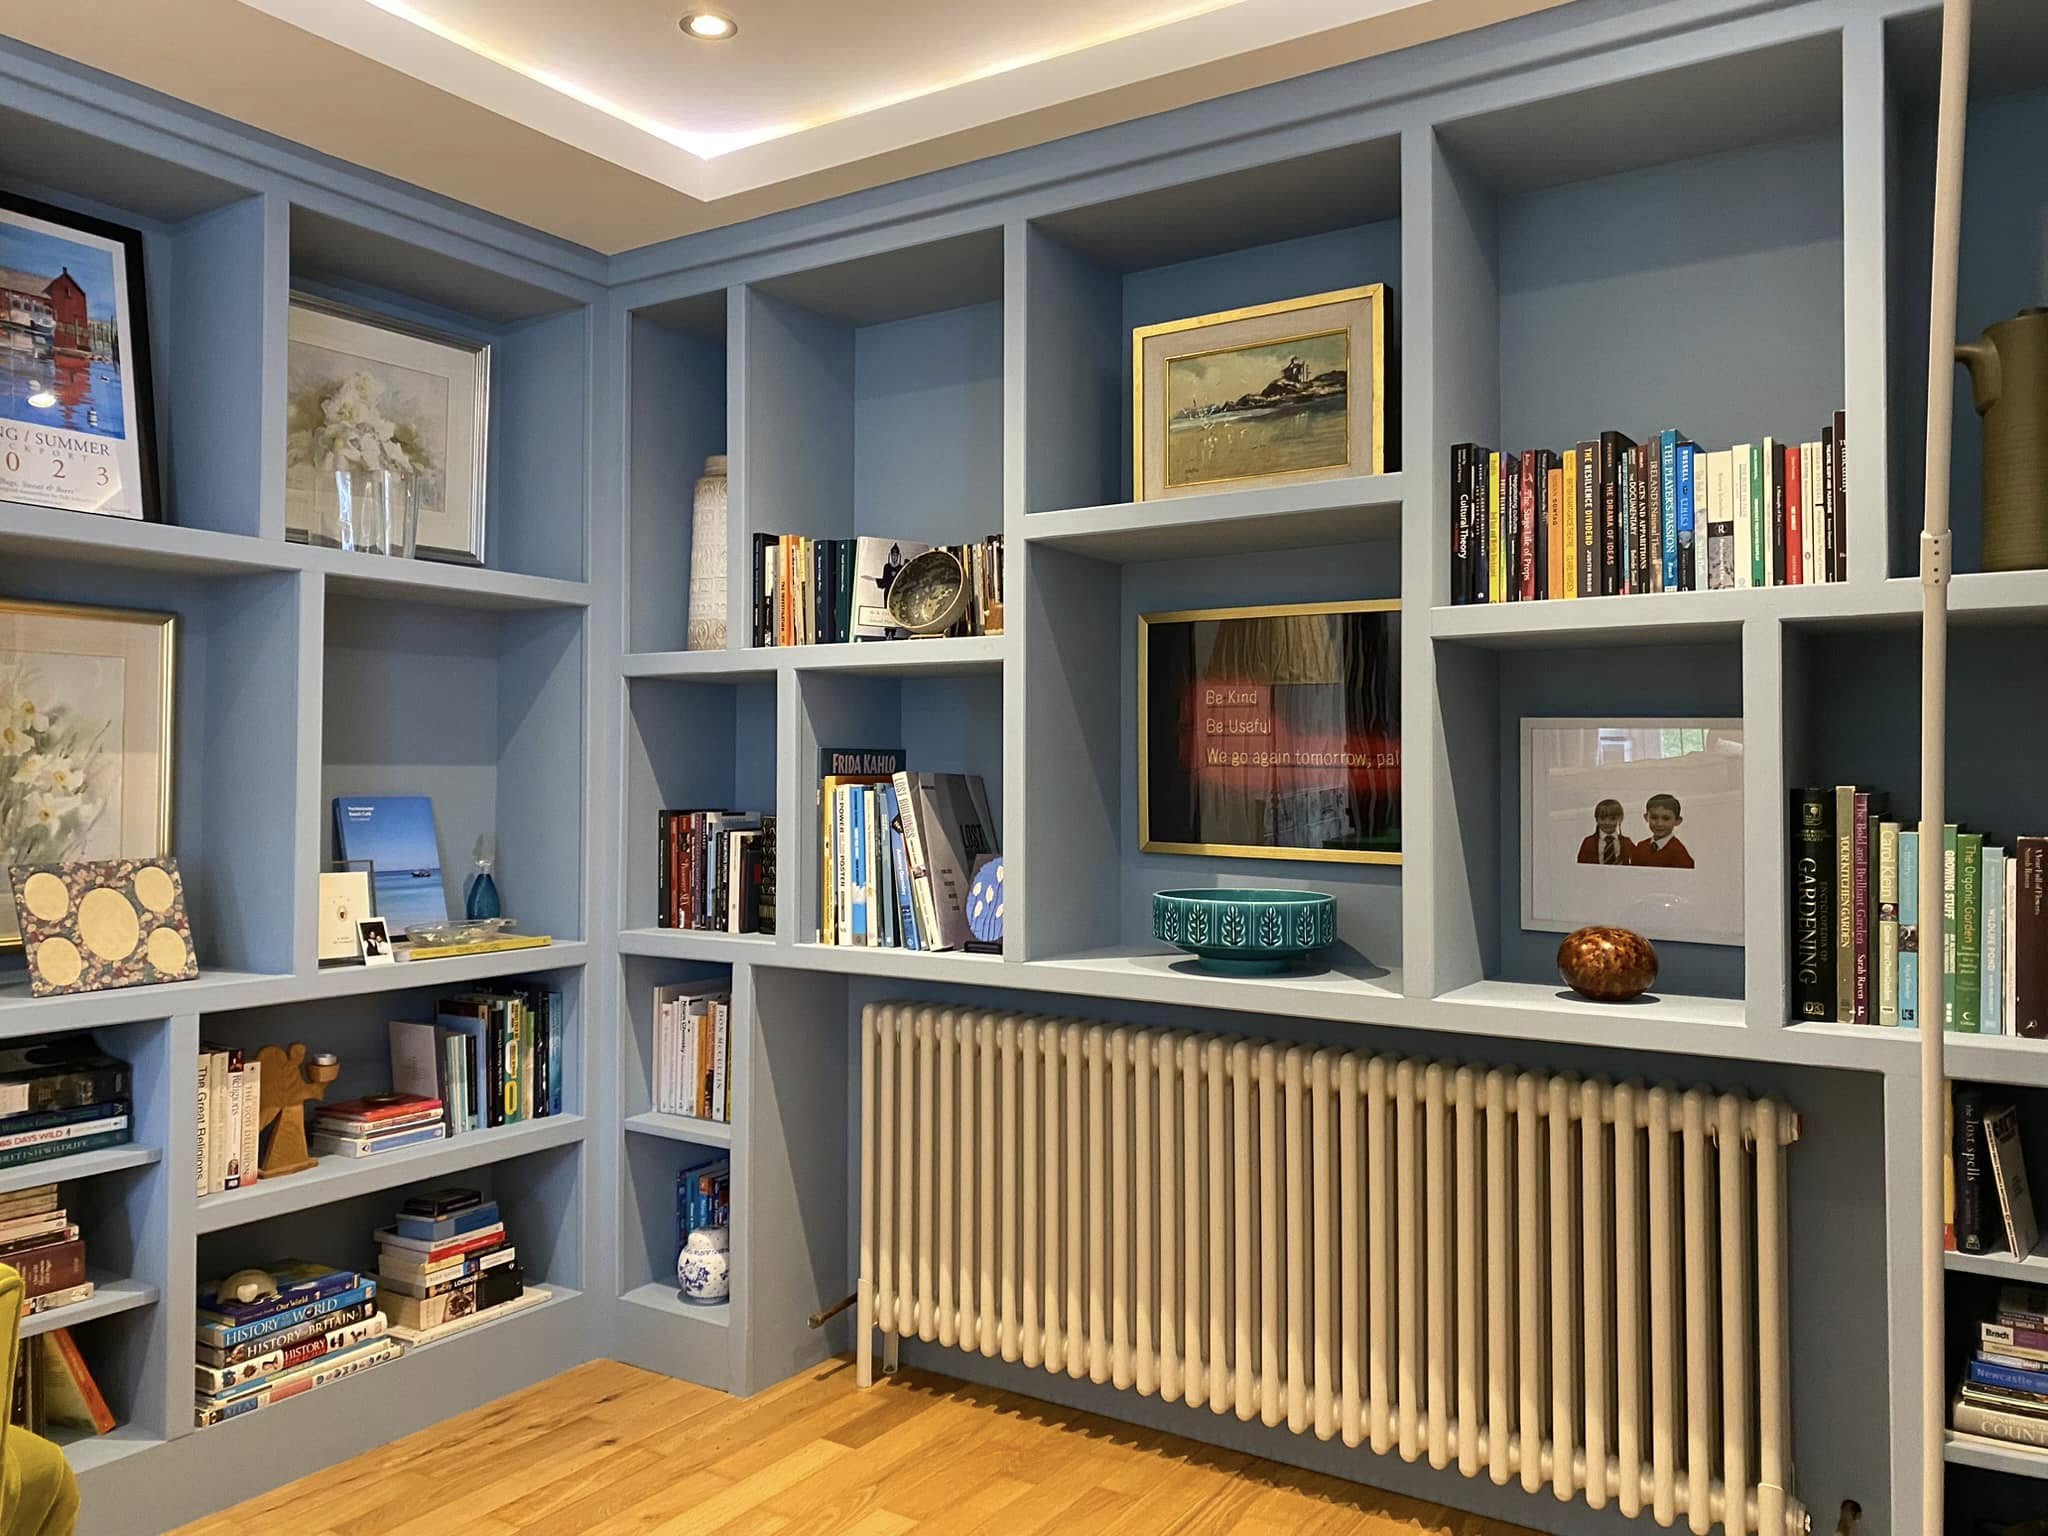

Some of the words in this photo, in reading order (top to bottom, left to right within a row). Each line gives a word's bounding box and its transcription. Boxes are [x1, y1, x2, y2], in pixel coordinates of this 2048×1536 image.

[35, 432, 111, 457] SUMMER
[1584, 448, 1592, 462] THE
[1665, 443, 1674, 464] THE
[1584, 464, 1593, 508] RESILIENCE
[1638, 480, 1646, 500] ACTS
[1665, 467, 1674, 510] PLAYER'S
[1459, 494, 1469, 529] Cultural
[1521, 508, 1532, 529] Stage
[1629, 481, 1637, 536] DOCUMENTARY
[1639, 501, 1647, 518] AND
[1523, 531, 1532, 546] Life
[1584, 510, 1593, 546] DIVIDEND
[1606, 530, 1613, 540] OF
[1666, 512, 1675, 553] PASSION
[1457, 530, 1469, 559] Theory
[1639, 519, 1647, 569] APPARITIONS
[1521, 558, 1532, 581] Props
[1205, 689, 1223, 705] Be
[1228, 689, 1257, 705] Kind
[1205, 718, 1224, 734] Be
[1228, 718, 1272, 735] Useful
[832, 753, 862, 774] FRIDA
[863, 754, 897, 775] KAHLO
[1206, 748, 1227, 765] We
[1231, 751, 1249, 767] go
[1252, 751, 1291, 768] again
[1296, 750, 1372, 769] tomorrow,
[894, 777, 907, 798] LOST
[899, 798, 916, 839] BUILDINGS
[1856, 800, 1868, 820] The
[1856, 823, 1868, 845] Bold
[1880, 830, 1895, 864] Carol
[1840, 835, 1850, 862] YOUR
[1856, 848, 1868, 864] and
[1965, 844, 1977, 864] The
[1881, 866, 1896, 897] Klein
[1944, 850, 1956, 891] GROWING
[1840, 862, 1850, 907] KITCHEN
[1856, 867, 1868, 906] Brilliant
[1961, 866, 1977, 905] Organic
[1944, 893, 1956, 920] STUFF
[1798, 857, 1817, 985] GARDENING
[1840, 907, 1850, 948] GARDEN
[1855, 909, 1867, 944] Garden
[1964, 907, 1976, 943] Garden
[1856, 953, 1867, 974] Sarah
[1857, 976, 1866, 999] Raven
[197, 1066, 208, 1088] The
[231, 1074, 241, 1116] Religions
[244, 1085, 253, 1102] THE
[197, 1092, 208, 1124] Great
[14, 1133, 38, 1145] DAYS
[39, 1129, 63, 1141] WILD
[1965, 1120, 1981, 1143] lost
[197, 1127, 208, 1180] Religions
[243, 1130, 252, 1176] DELUSION
[1961, 1147, 1981, 1182] spells
[454, 1275, 478, 1288] LONDON
[226, 1318, 279, 1346] HISTORY
[293, 1298, 338, 1321] WORLD
[247, 1329, 303, 1358] HISTORY
[308, 1310, 357, 1335] BRITAIN
[285, 1338, 327, 1359] HISTORY
[1976, 1368, 2033, 1386] Newcastle
